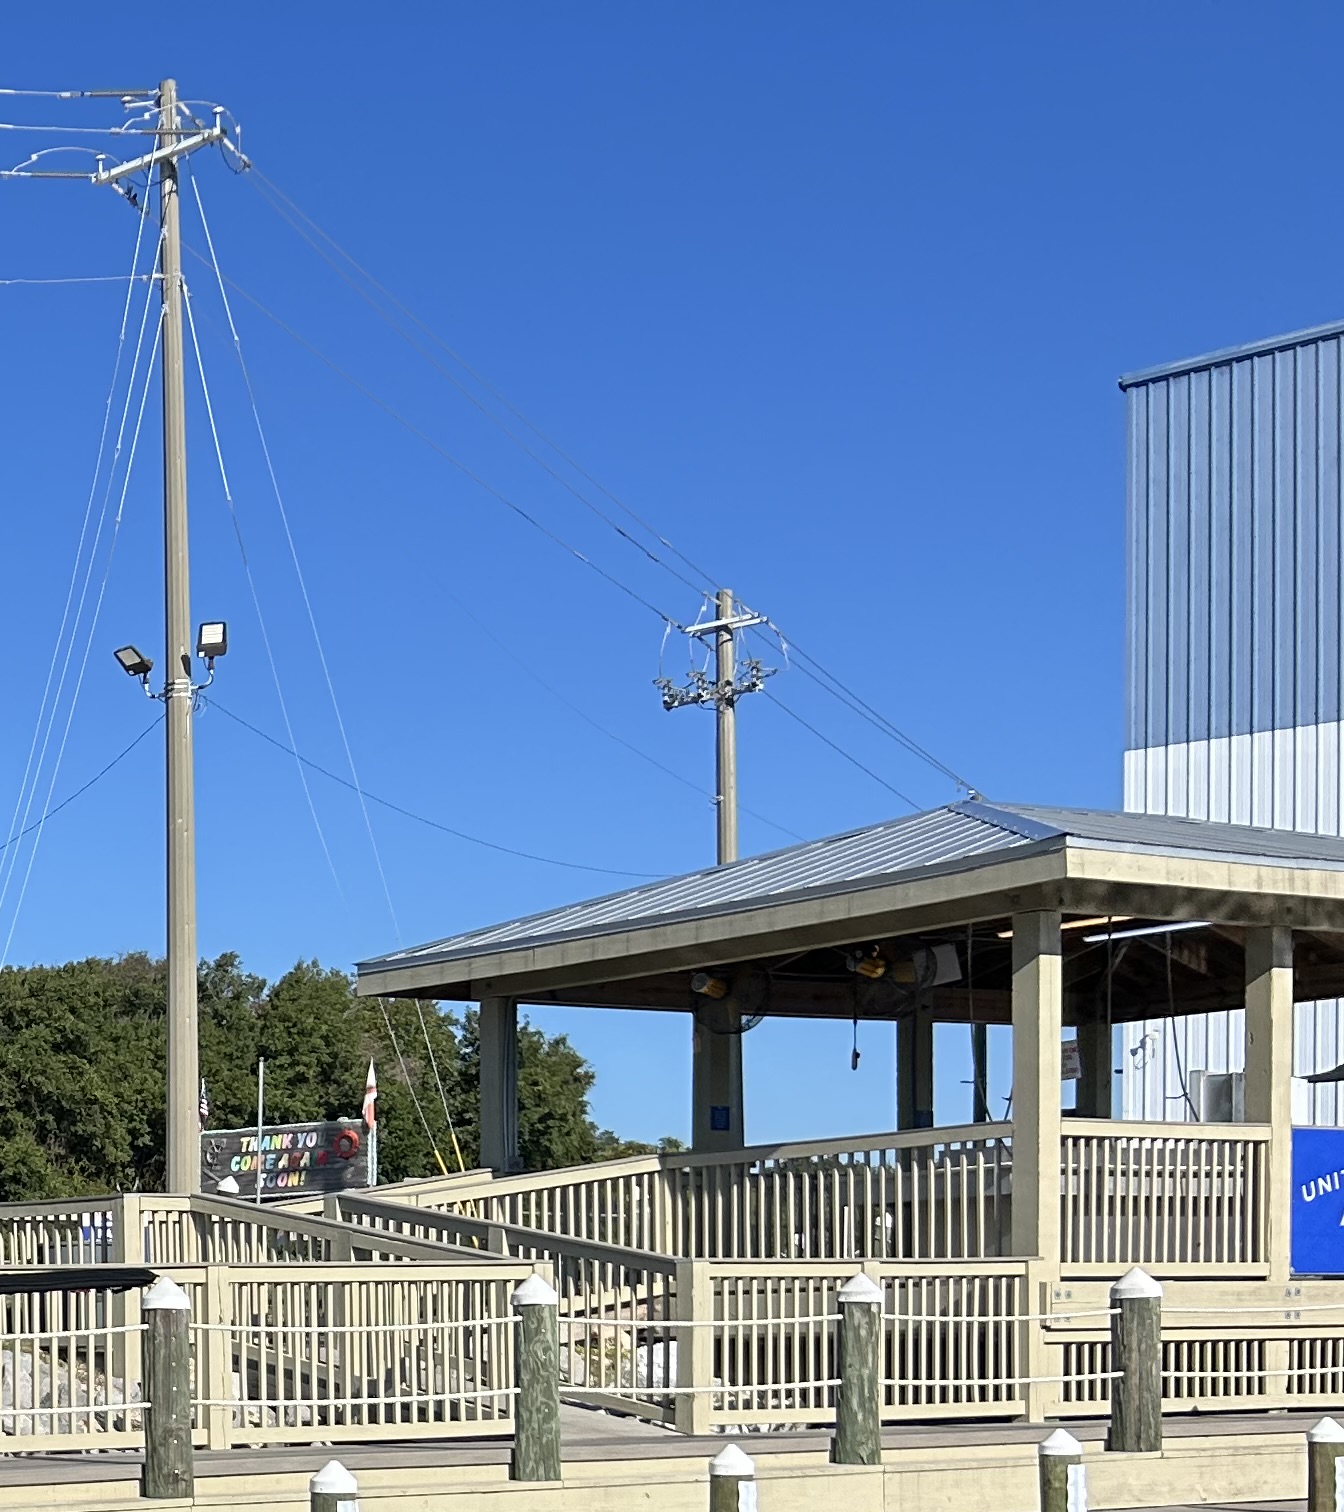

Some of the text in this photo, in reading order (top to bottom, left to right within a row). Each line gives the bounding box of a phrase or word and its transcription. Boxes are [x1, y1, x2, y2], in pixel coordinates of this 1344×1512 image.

[240, 1132, 326, 1153] THANK YOU
[231, 1154, 276, 1172] COME
[255, 1170, 306, 1188] SOON!
